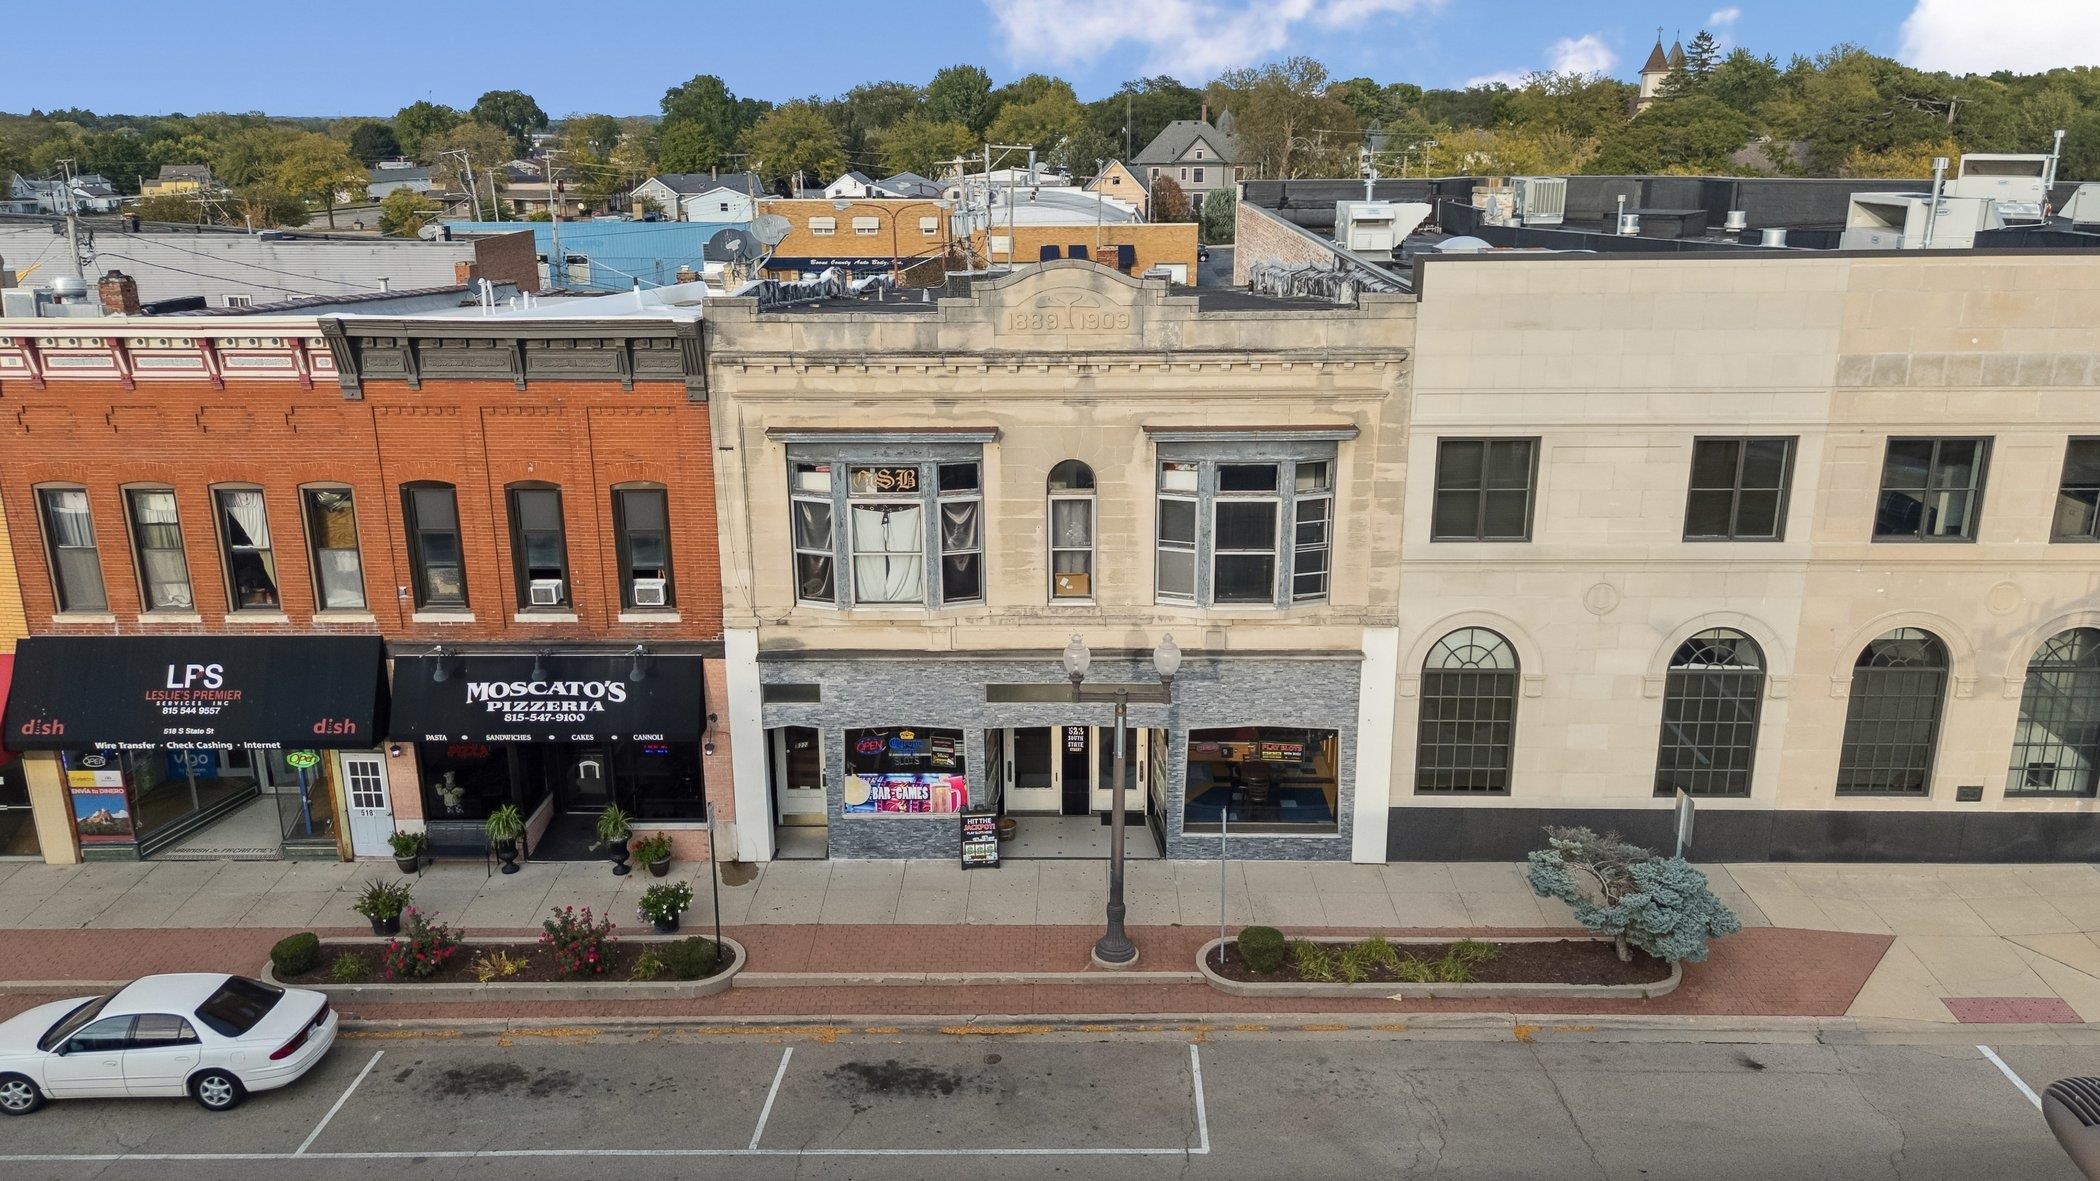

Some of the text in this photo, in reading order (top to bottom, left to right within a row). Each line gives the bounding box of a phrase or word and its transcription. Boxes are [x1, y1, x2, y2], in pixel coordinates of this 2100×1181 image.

[1008, 312, 1130, 331] 1889 1909
[166, 663, 224, 689] LPS
[145, 690, 242, 700] LESLIE'S PREMIER
[466, 680, 627, 704] MOSCATO'S
[162, 707, 221, 715] 815 544 9557
[486, 701, 605, 712] PIZZERIA
[504, 713, 586, 722] 815-547-9100
[21, 718, 65, 735] dish
[313, 718, 357, 735] dish
[196, 742, 233, 750] Cashing
[243, 741, 281, 749] Internet
[856, 741, 883, 751] OPEN
[174, 754, 209, 767] vgo
[873, 786, 929, 800] BAR GAMES
[361, 809, 374, 817] 518
